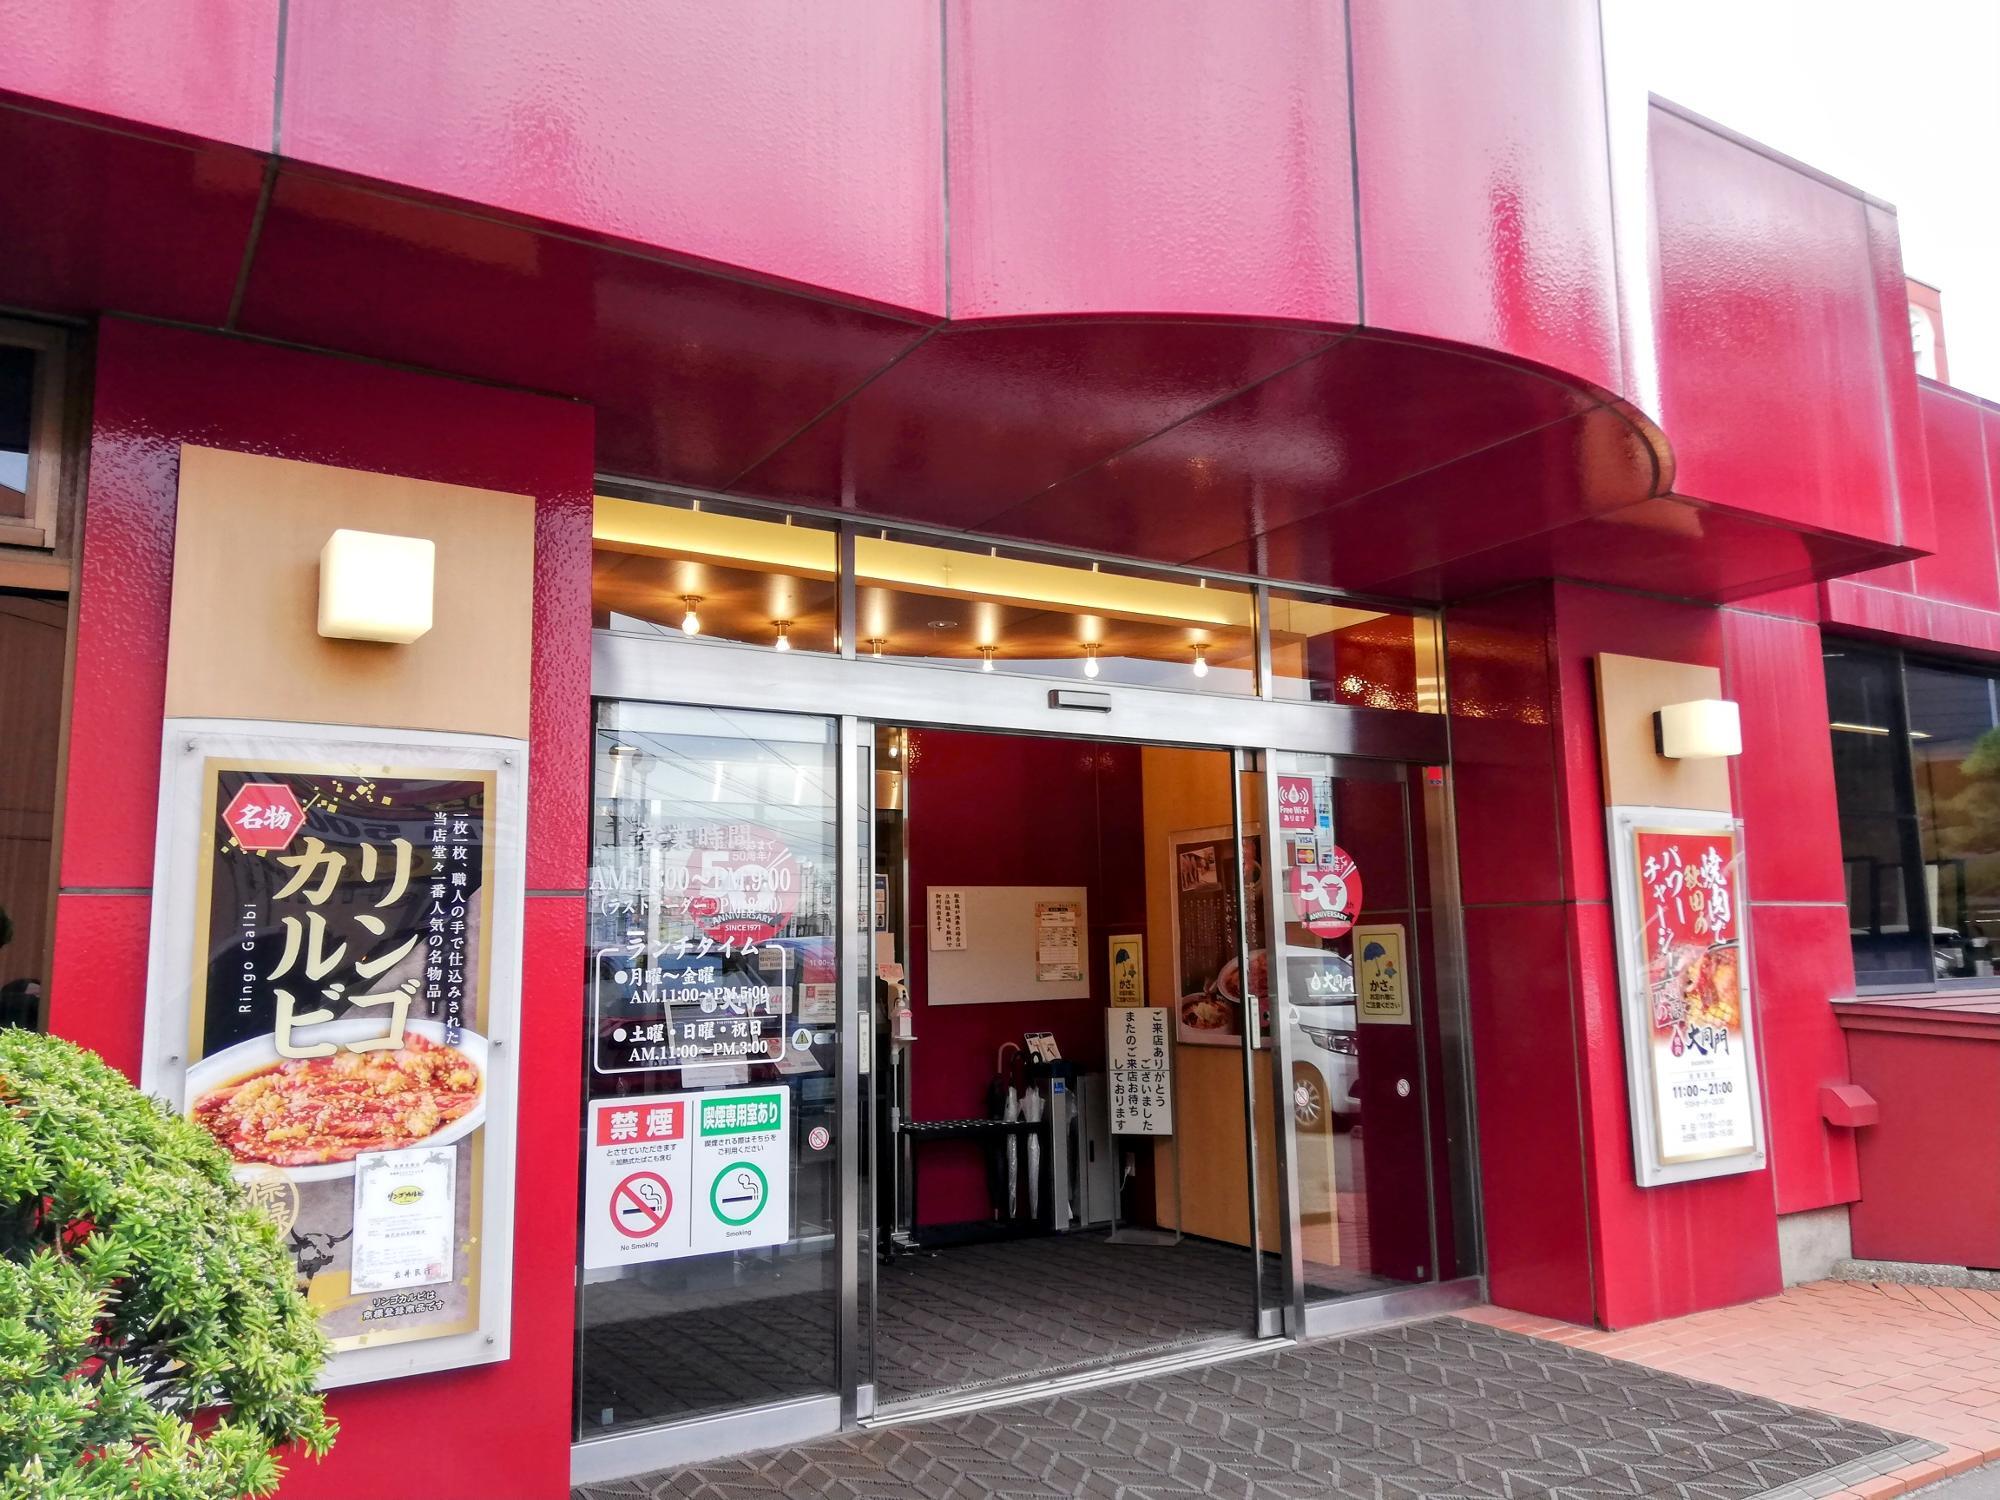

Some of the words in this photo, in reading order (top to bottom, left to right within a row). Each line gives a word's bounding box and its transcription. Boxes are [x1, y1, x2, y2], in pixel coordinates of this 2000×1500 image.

[235, 803, 293, 831] 名物
[1280, 806, 1293, 814] Free
[1294, 806, 1309, 814] Wi-Fi
[1662, 846, 1686, 925] パワー
[1684, 863, 1708, 935] 秋田の
[1701, 846, 1731, 945] 焼肉で
[241, 903, 257, 951] Galbi
[445, 812, 469, 1045] 一枚一枚、職人の手で仕込みされた
[712, 912, 774, 925] ANNIVERSARY
[1309, 911, 1348, 921] ANNIVERSARY
[266, 836, 347, 1059] カルビ
[344, 837, 421, 1055] リンゴ
[627, 931, 759, 960] ランチタイム
[238, 962, 256, 1013] Ringo
[1686, 1023, 1730, 1056] 大同門
[1126, 1011, 1139, 1117] またのご来店お待ち
[1152, 1010, 1165, 1107] ご来店ありがとう
[1114, 1058, 1126, 1131] しております
[1140, 1058, 1153, 1131] ございました
[703, 1102, 778, 1130] 喫煙専用室あり
[606, 1144, 677, 1157] とさせていただきます
[704, 1134, 777, 1147] 喫煙される際はそちらを
[718, 1145, 764, 1156] ご利用ください
[620, 1244, 630, 1252] No
[631, 1241, 659, 1250] Smoking
[726, 1229, 752, 1238] Smoking
[373, 1290, 437, 1307] リンゴカルビは
